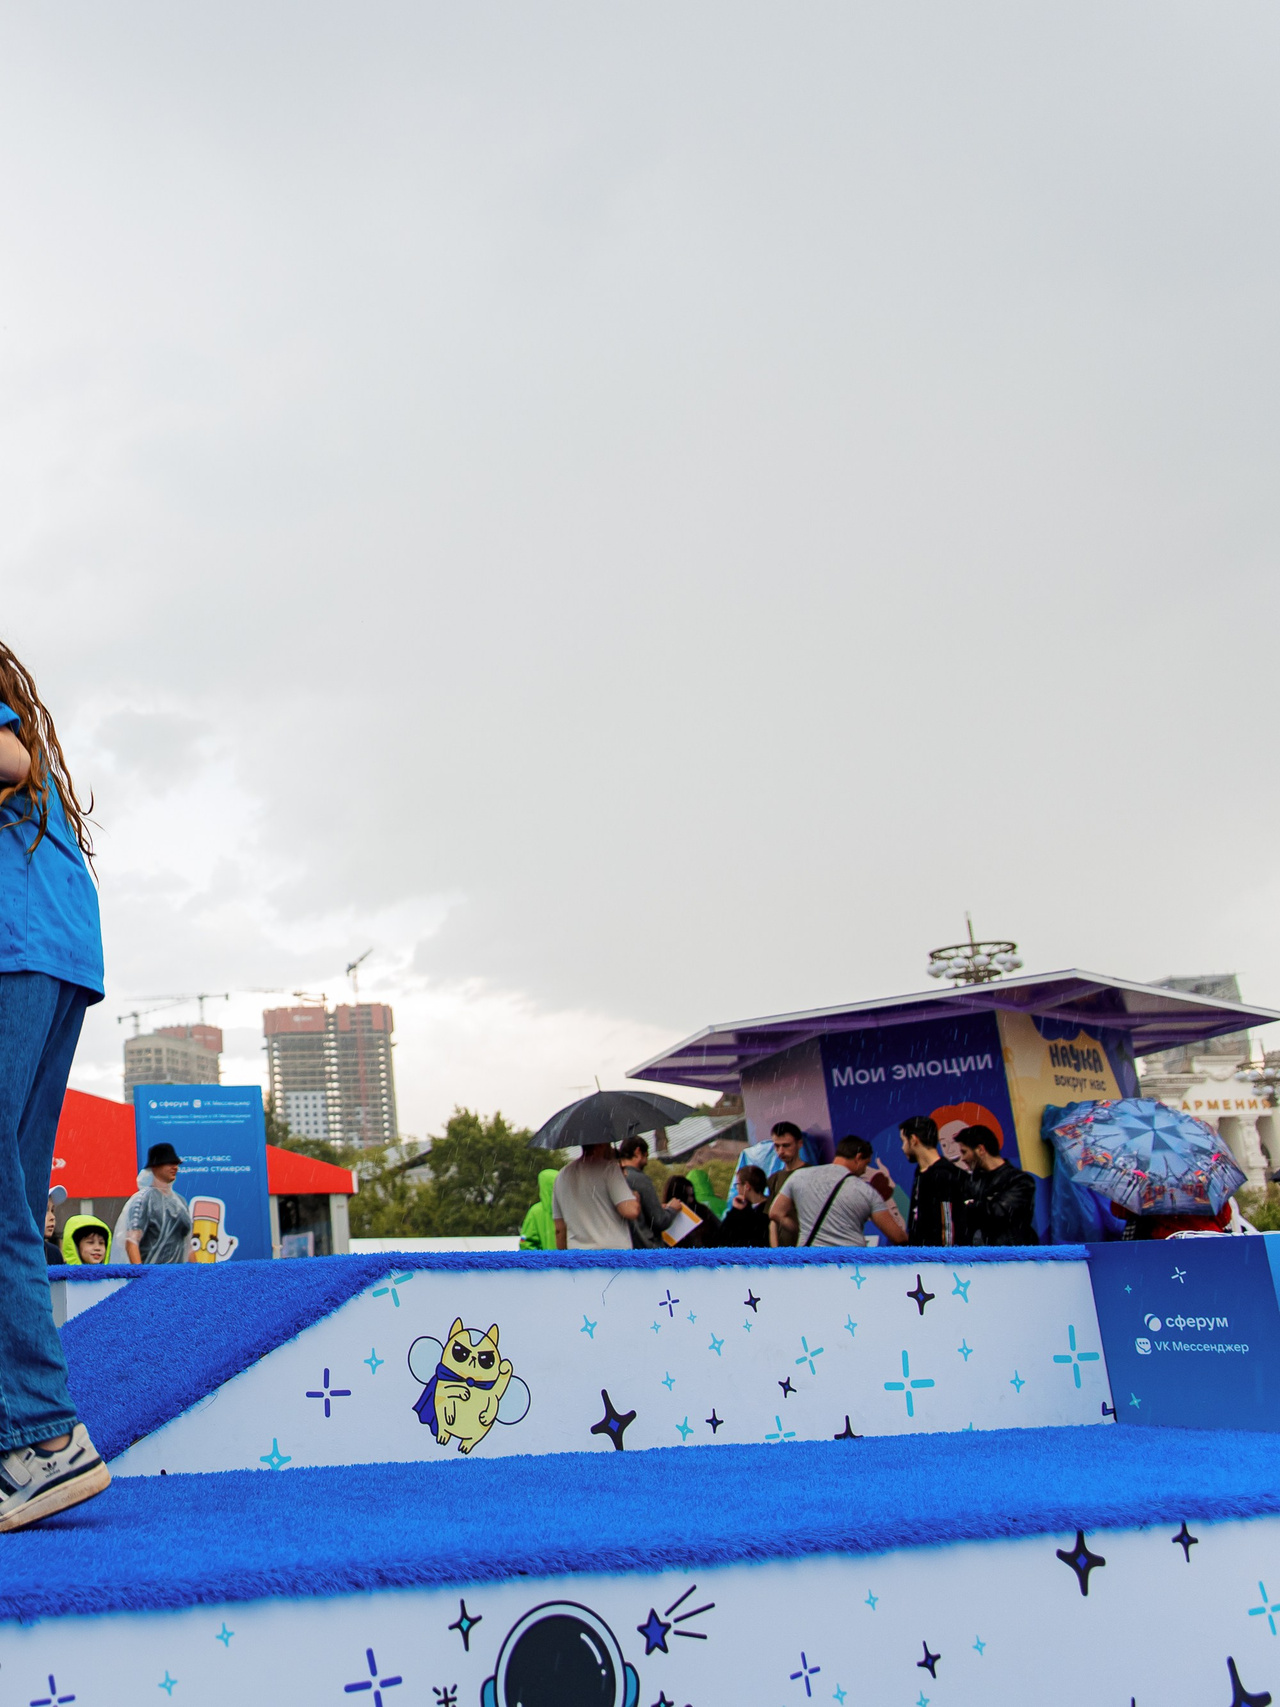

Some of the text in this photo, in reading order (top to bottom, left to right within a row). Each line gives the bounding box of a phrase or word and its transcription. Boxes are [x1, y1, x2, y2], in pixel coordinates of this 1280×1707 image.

[1049, 1043, 1104, 1073] НАУКА
[832, 1054, 993, 1087] Мои эмоции
[1054, 1075, 1107, 1092] вокруг нас
[1182, 1099, 1271, 1110] АРМЕНИЯ
[1165, 1314, 1229, 1331] сферум
[1154, 1341, 1250, 1354] VK Мессенджер
